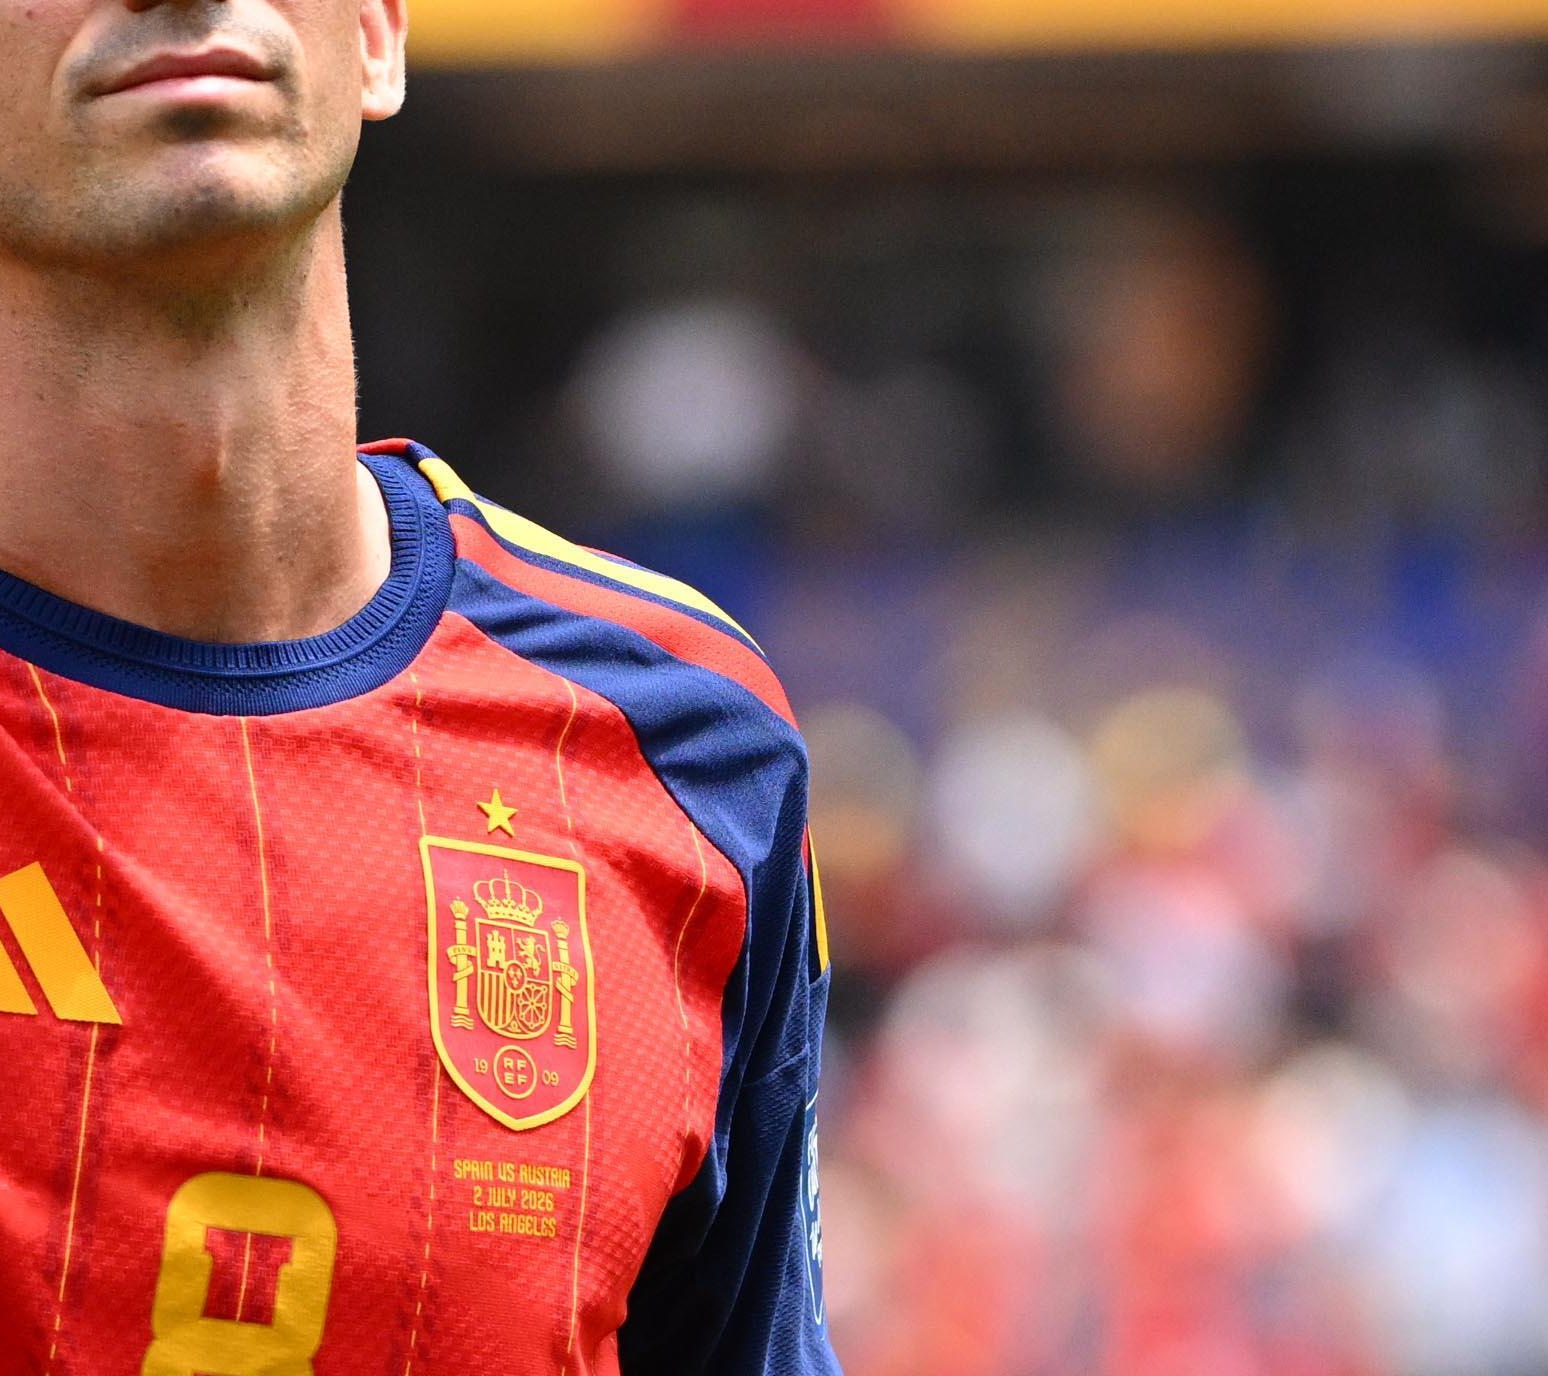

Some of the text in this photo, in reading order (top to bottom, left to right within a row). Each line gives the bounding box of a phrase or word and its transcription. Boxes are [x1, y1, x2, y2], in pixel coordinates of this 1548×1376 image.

[474, 1057, 488, 1074] 19
[542, 1069, 559, 1087] 09
[453, 1159, 494, 1181] SPAIN
[519, 1164, 571, 1188] AUSTRIA
[473, 1185, 555, 1212] 2 JULY 2026
[469, 1210, 557, 1238] LOS ANGELES
